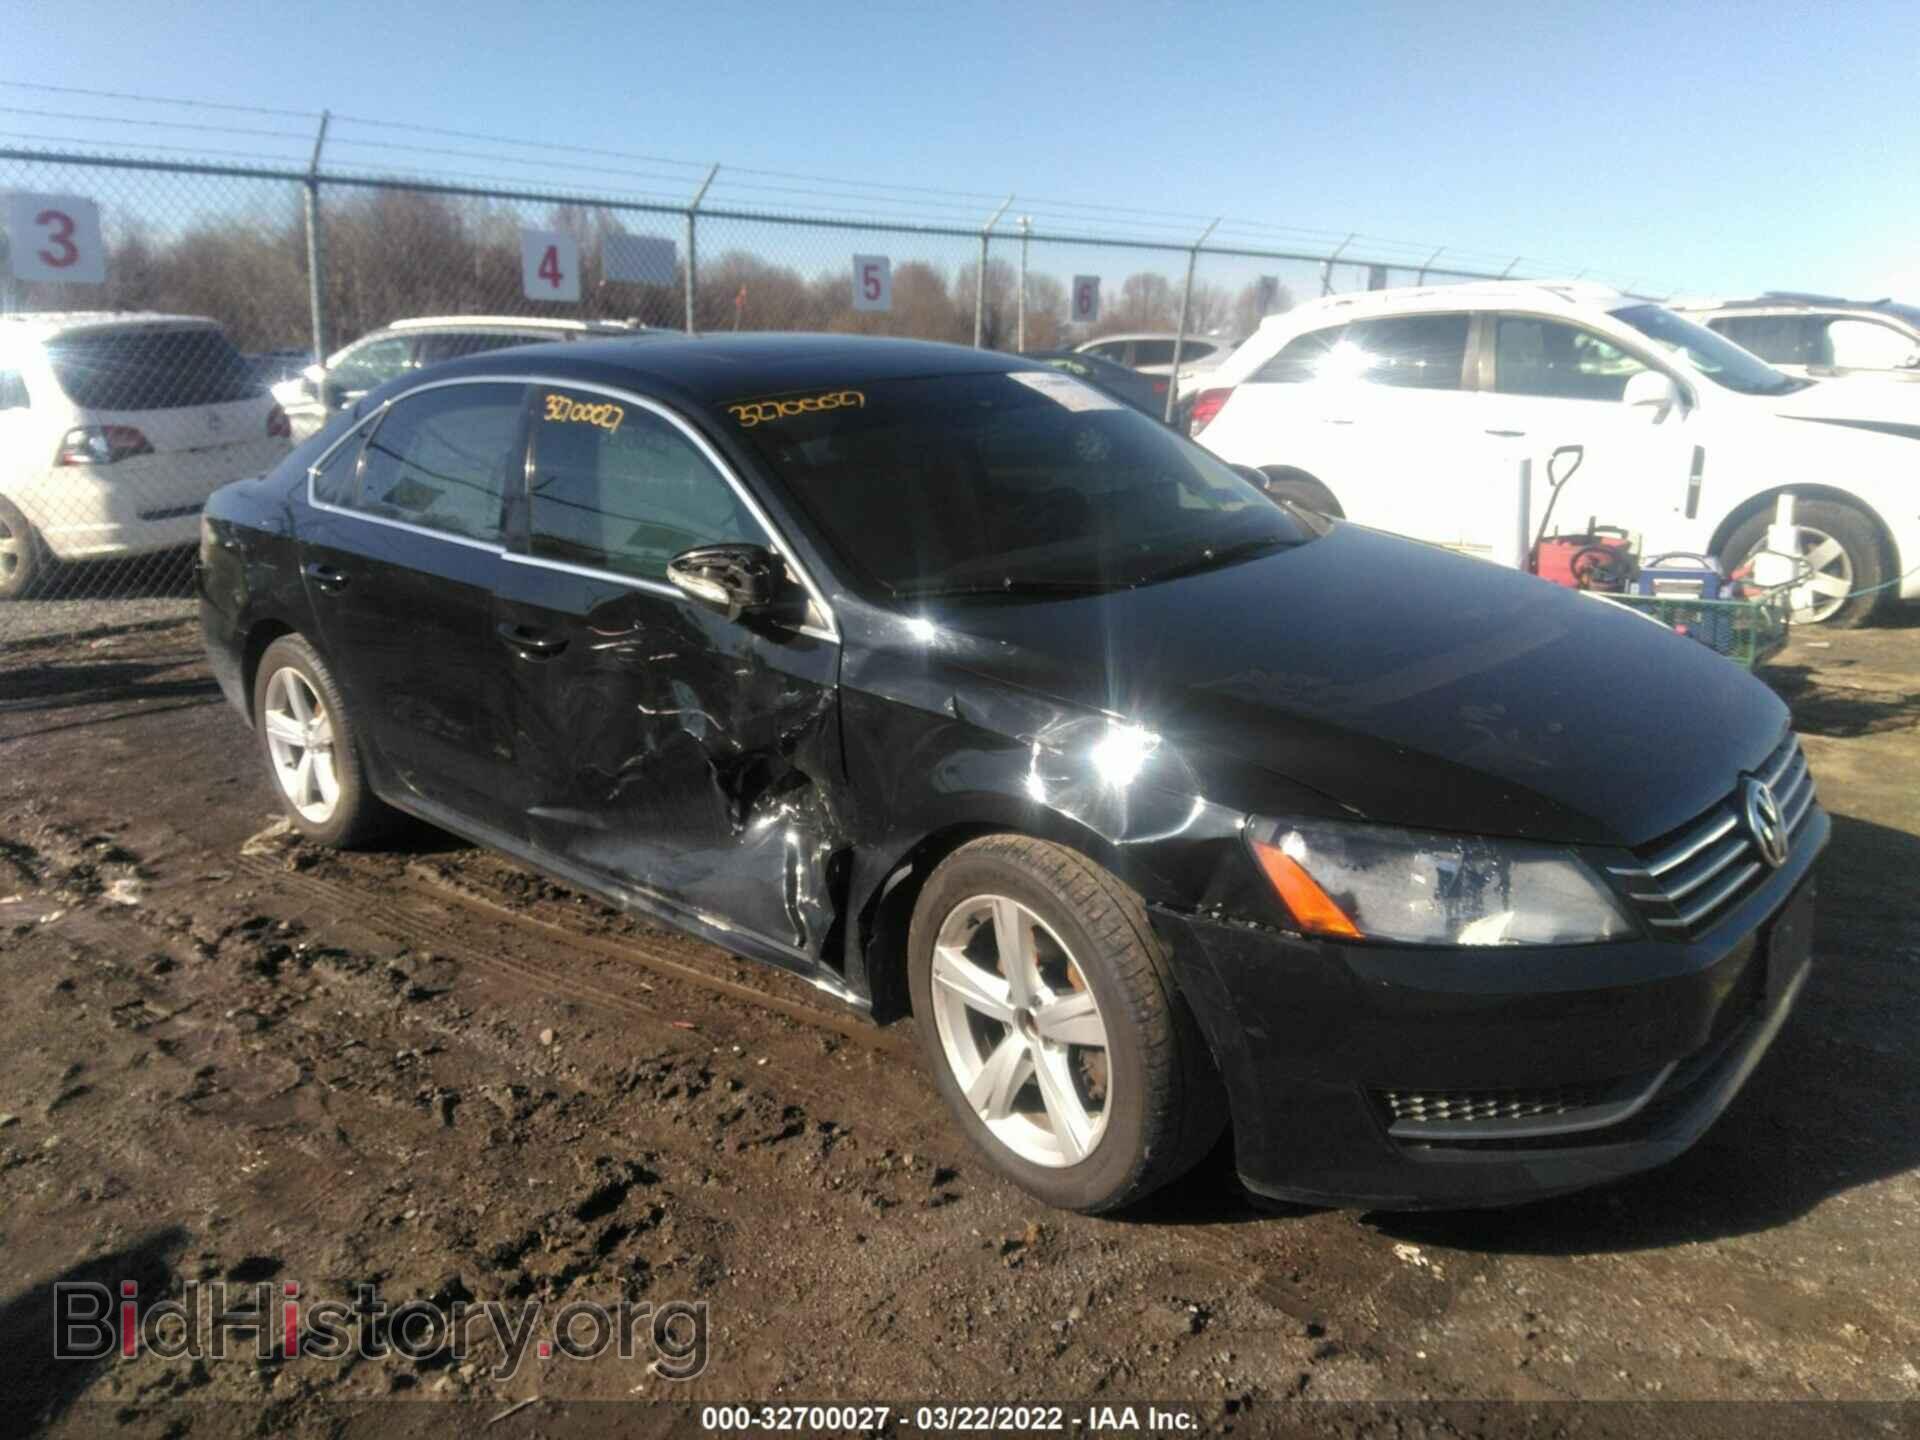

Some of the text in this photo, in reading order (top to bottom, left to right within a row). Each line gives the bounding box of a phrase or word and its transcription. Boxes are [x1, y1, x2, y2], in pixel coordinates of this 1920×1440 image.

[35, 209, 80, 269] 3
[538, 246, 564, 289] 4
[863, 264, 881, 301] 5
[1078, 282, 1092, 316] 6
